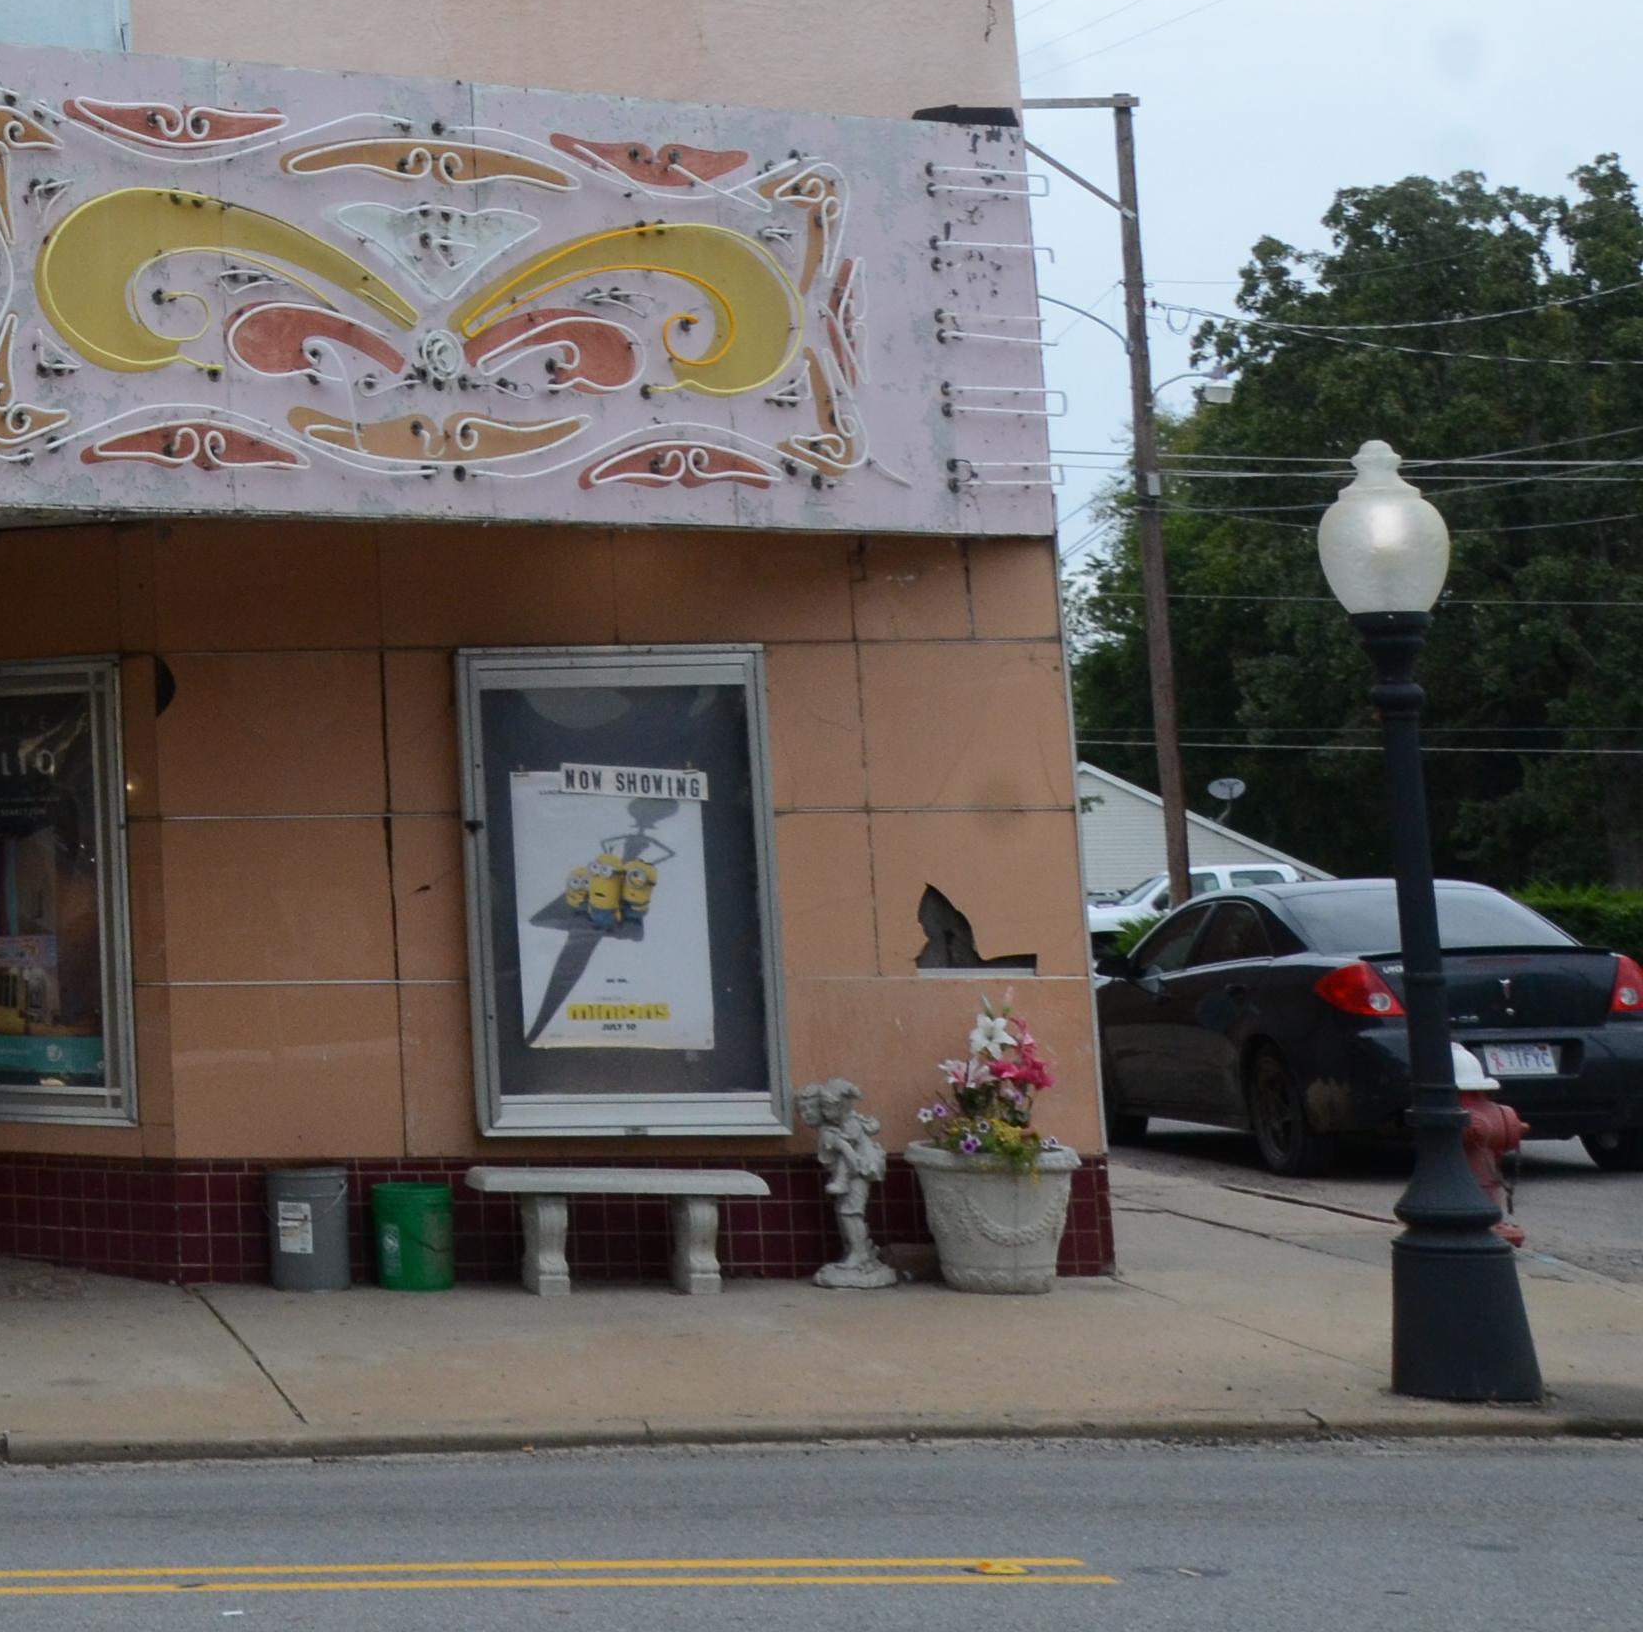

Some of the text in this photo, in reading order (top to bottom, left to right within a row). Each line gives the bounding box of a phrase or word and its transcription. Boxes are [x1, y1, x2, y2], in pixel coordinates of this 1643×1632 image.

[565, 770, 700, 798] NOW SHOWING
[602, 1023, 622, 1031] JULY
